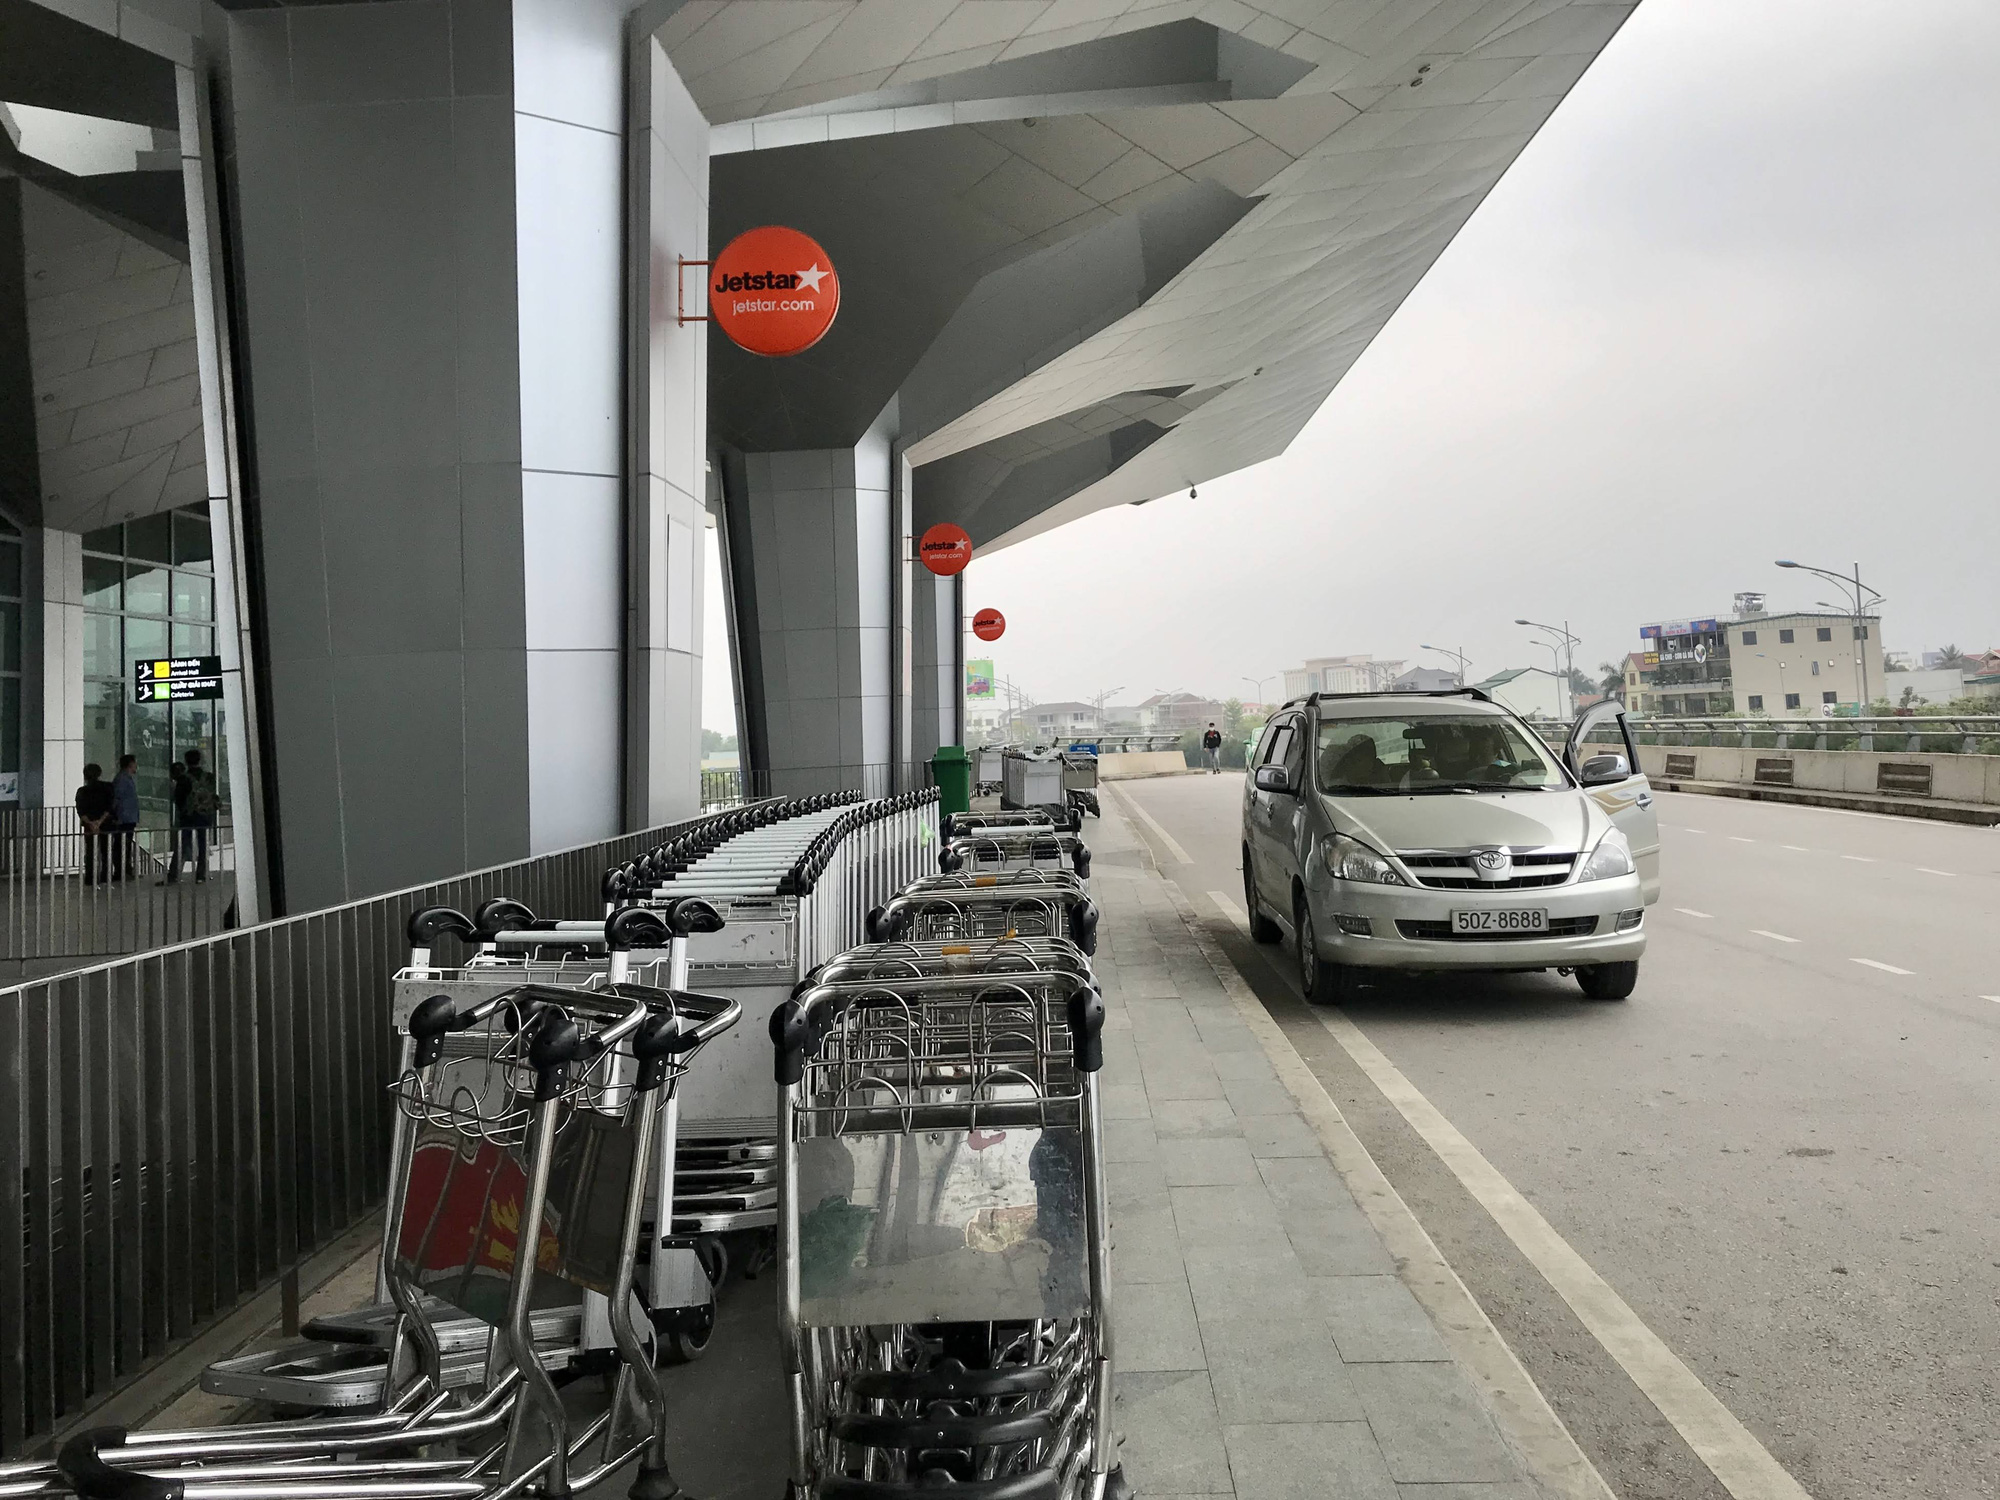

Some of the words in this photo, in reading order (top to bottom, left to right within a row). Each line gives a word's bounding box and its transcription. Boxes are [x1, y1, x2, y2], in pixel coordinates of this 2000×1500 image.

[715, 270, 802, 293] Jetstar
[732, 298, 815, 316] jetstar.com
[922, 541, 957, 551] Jetstar
[1458, 911, 1542, 930] 50Z-8688
